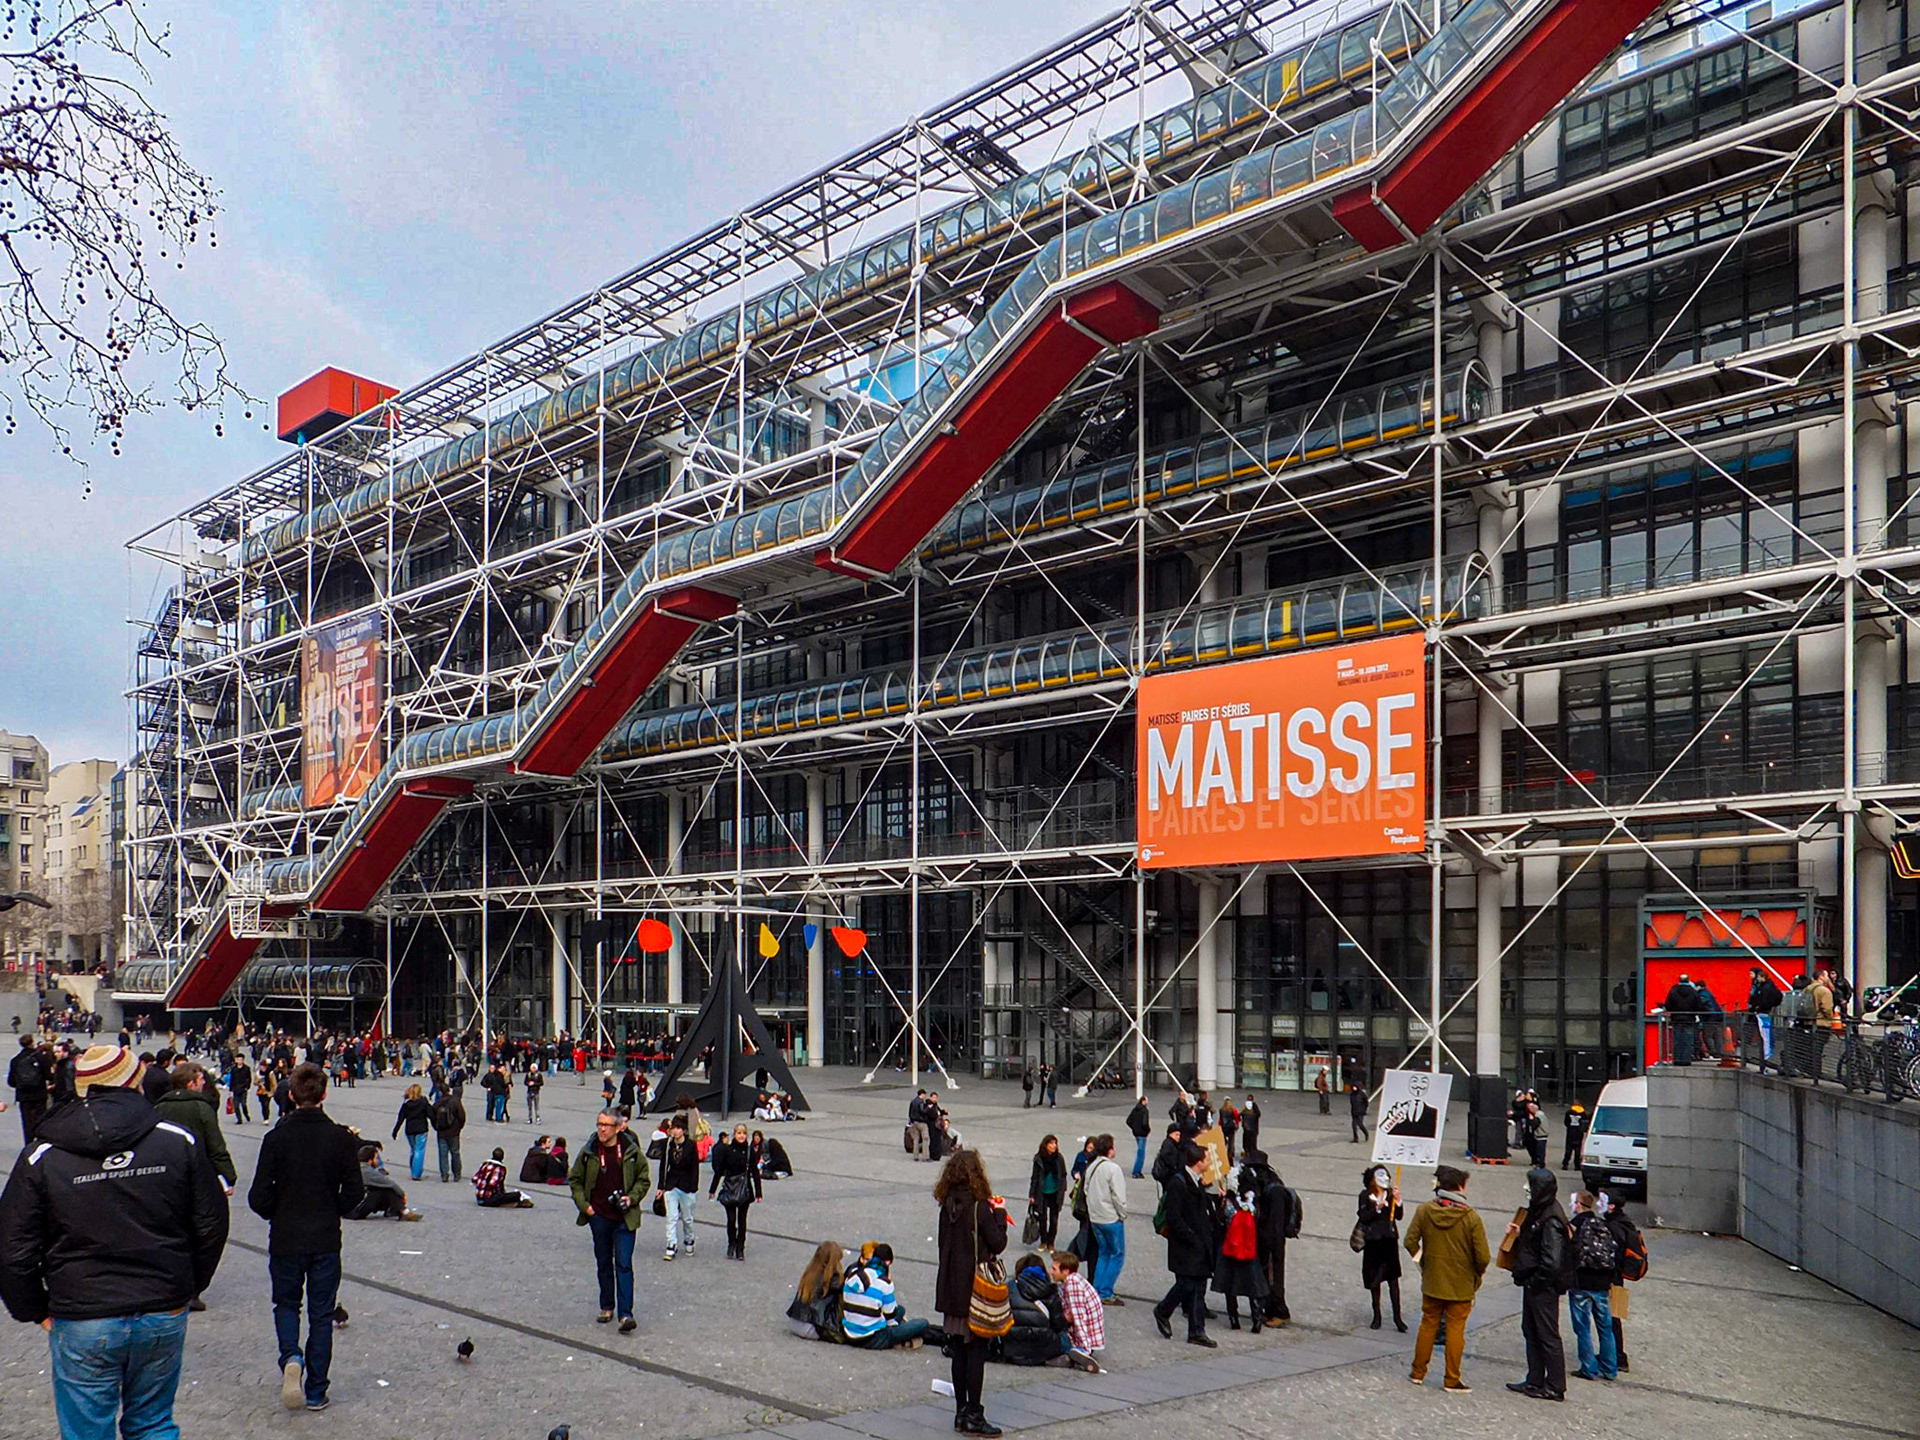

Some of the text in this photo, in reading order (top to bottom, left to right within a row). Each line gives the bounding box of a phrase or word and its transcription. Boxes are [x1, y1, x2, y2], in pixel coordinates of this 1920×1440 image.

[1148, 702, 1250, 726] MATISSE PAIRES ET SÉRIES
[1147, 692, 1416, 811] MATISSE
[1147, 788, 1246, 838] PAIRES
[1256, 786, 1287, 830] ET
[73, 1165, 167, 1185] ITALIAN SPORT DESIGN
